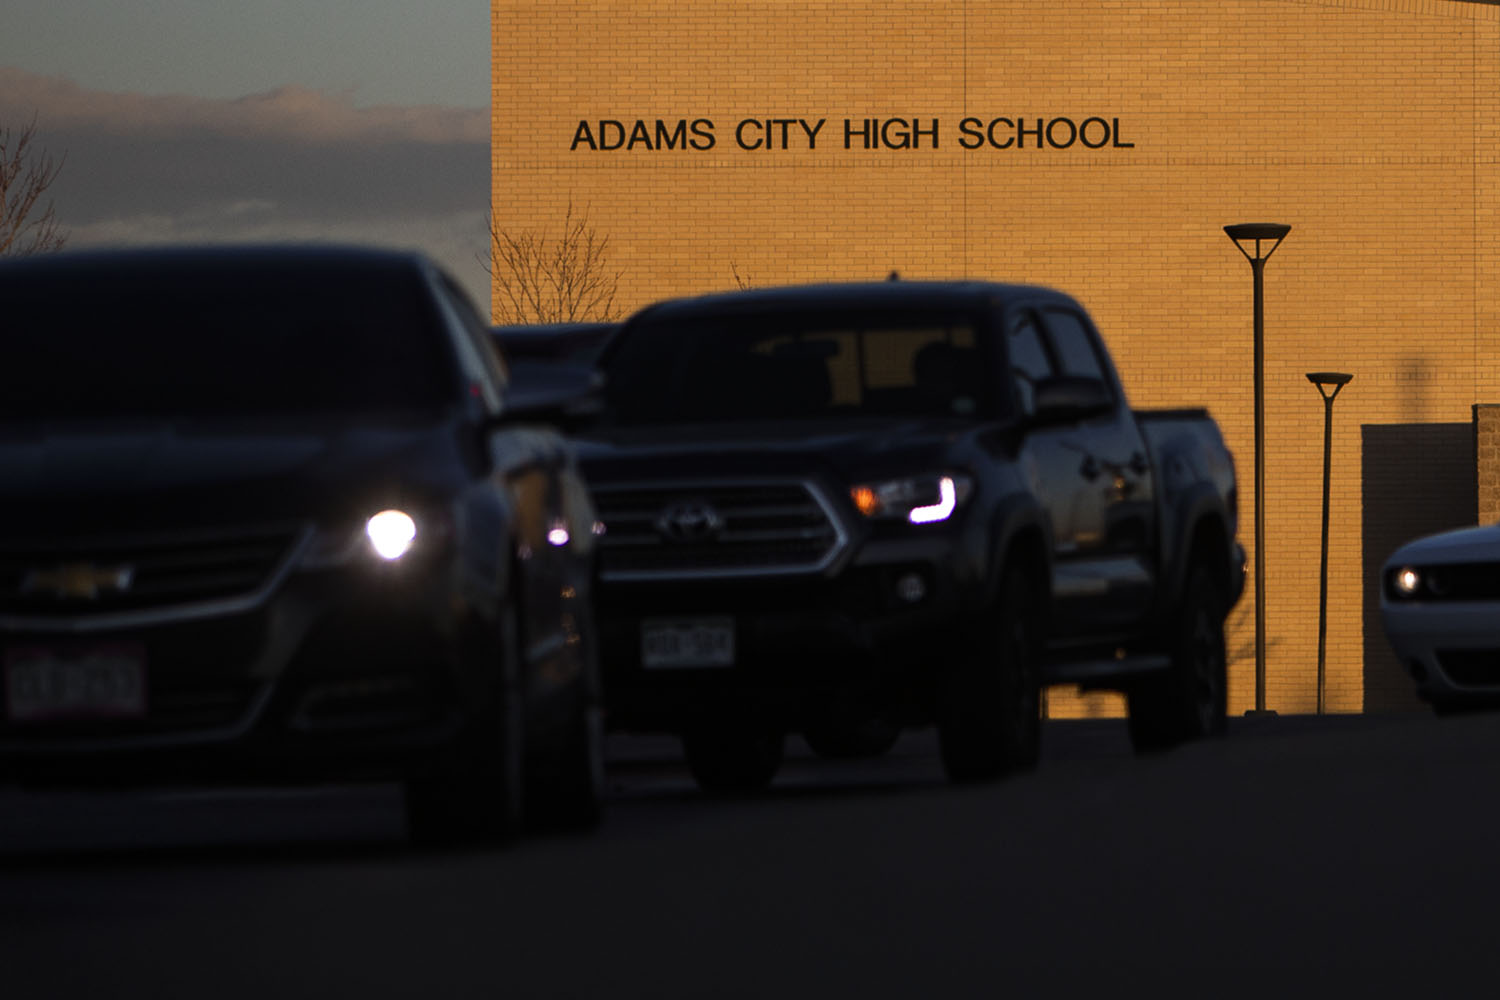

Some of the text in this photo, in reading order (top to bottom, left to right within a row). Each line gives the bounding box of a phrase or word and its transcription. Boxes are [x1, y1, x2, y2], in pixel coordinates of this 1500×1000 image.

[570, 116, 1135, 151] ADAMS CITY HIGH SCHOOL
